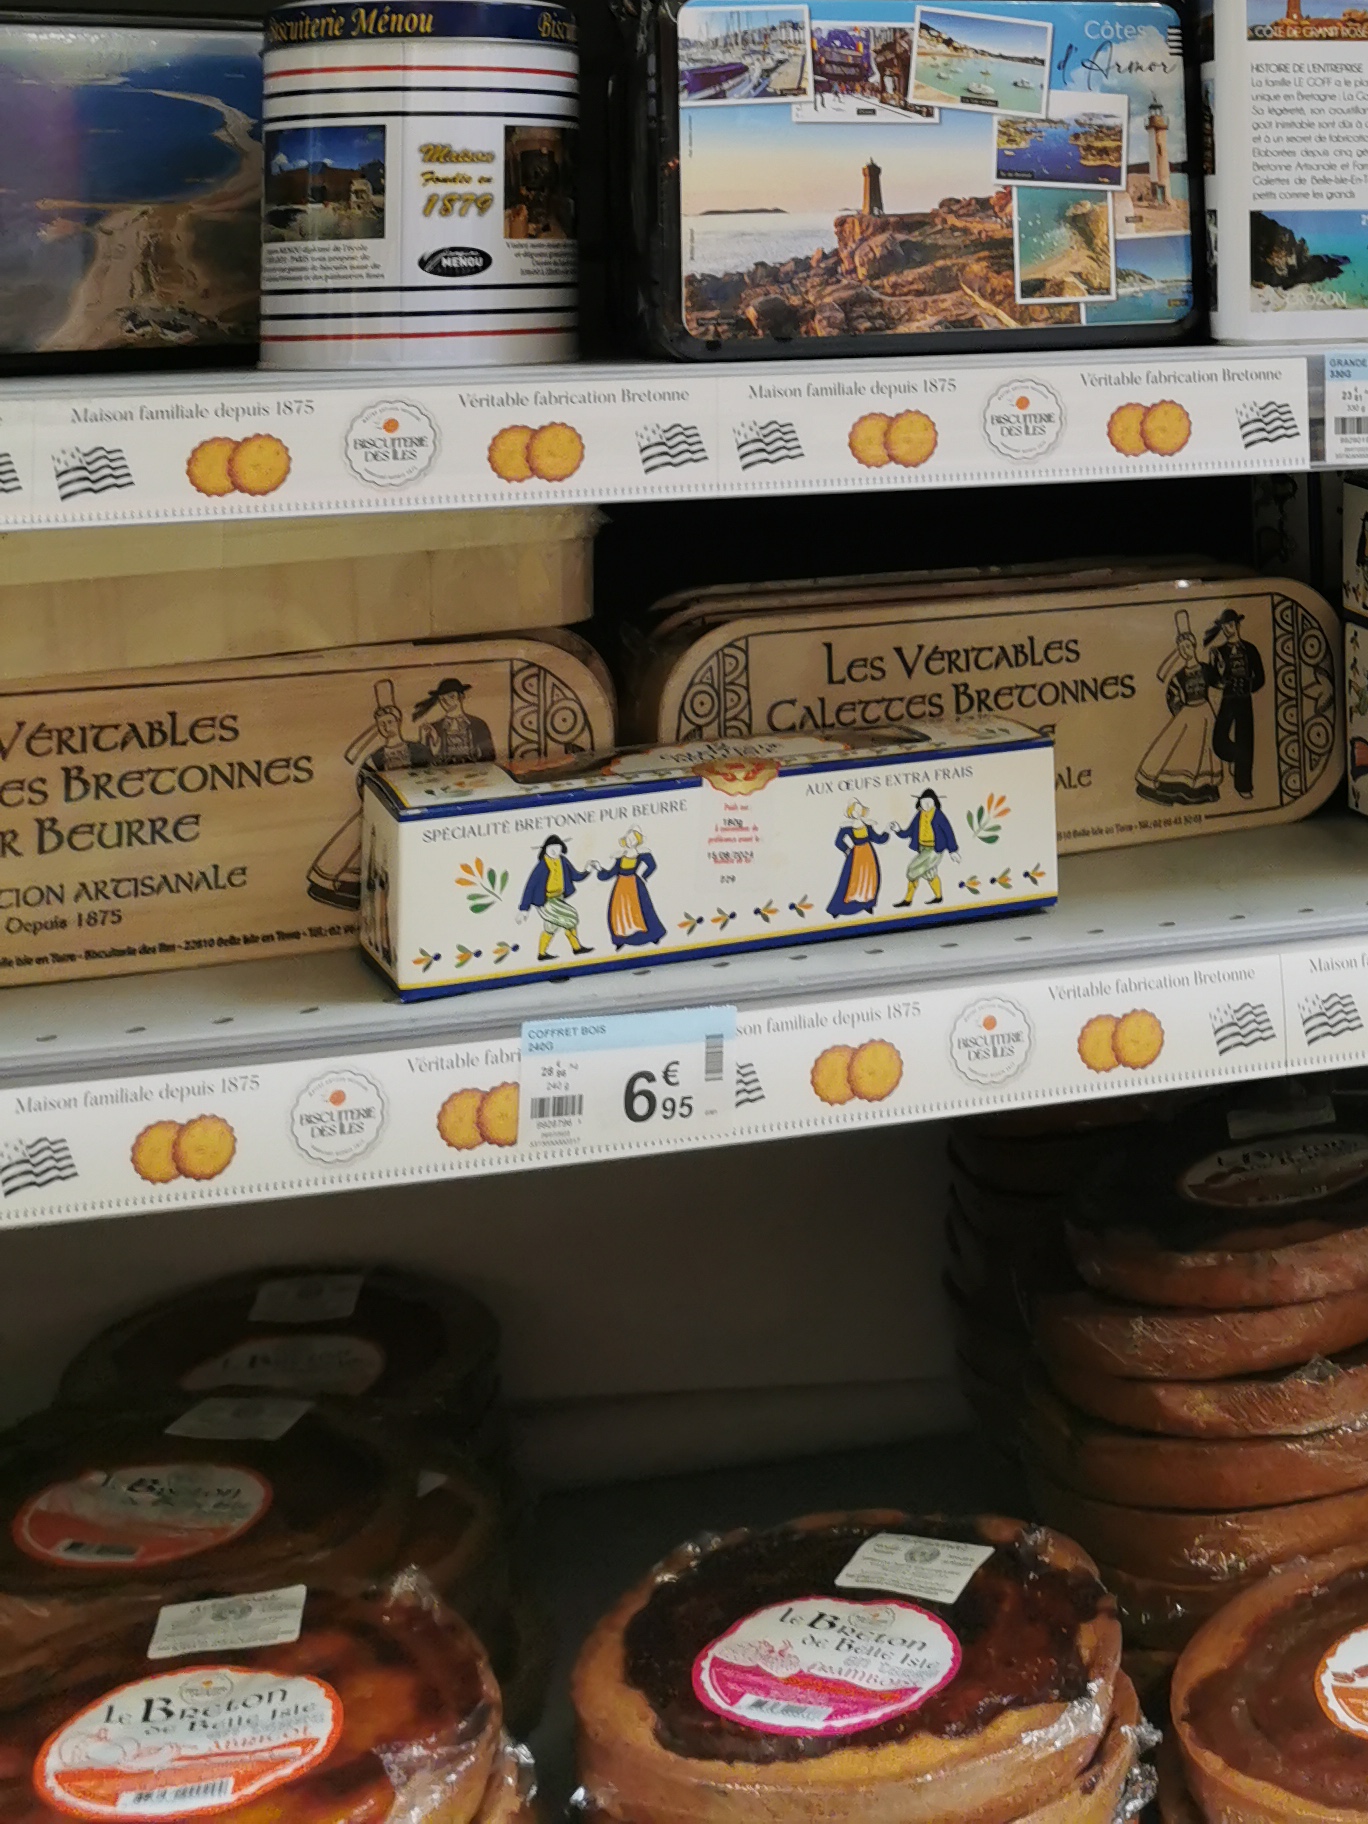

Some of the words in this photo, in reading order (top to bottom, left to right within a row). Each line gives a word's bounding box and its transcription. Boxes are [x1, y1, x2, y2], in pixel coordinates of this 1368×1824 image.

[350, 5, 434, 37] Ménou
[419, 143, 497, 164] Maison
[422, 193, 494, 219] 1879
[441, 252, 483, 269] MENOU
[1329, 358, 1368, 368] GRANDE
[458, 391, 530, 408] Véritable
[533, 390, 617, 406] fabrication
[621, 388, 690, 403] Bretonne
[71, 407, 134, 424] Maison
[139, 403, 210, 421] familiale
[213, 402, 270, 423] depuis
[276, 399, 315, 416] 1875
[806, 782, 834, 795] AUX
[885, 770, 931, 787] EXTRA
[934, 765, 974, 781] FRAIS
[422, 816, 509, 843] SPÉCIALITÉ
[514, 812, 596, 833] BRETONNE
[599, 808, 632, 822] PUR
[634, 800, 687, 817] BEURRE
[76, 909, 122, 927] 1875
[527, 1026, 577, 1040] COFFRET
[580, 1024, 607, 1036] BOIS
[662, 1060, 680, 1087] €
[15, 1093, 78, 1115] Maison
[83, 1085, 154, 1108] familiale
[158, 1080, 215, 1103] depuis
[221, 1074, 260, 1094] 1875
[624, 1070, 657, 1123] 6
[662, 1095, 694, 1120] 95
